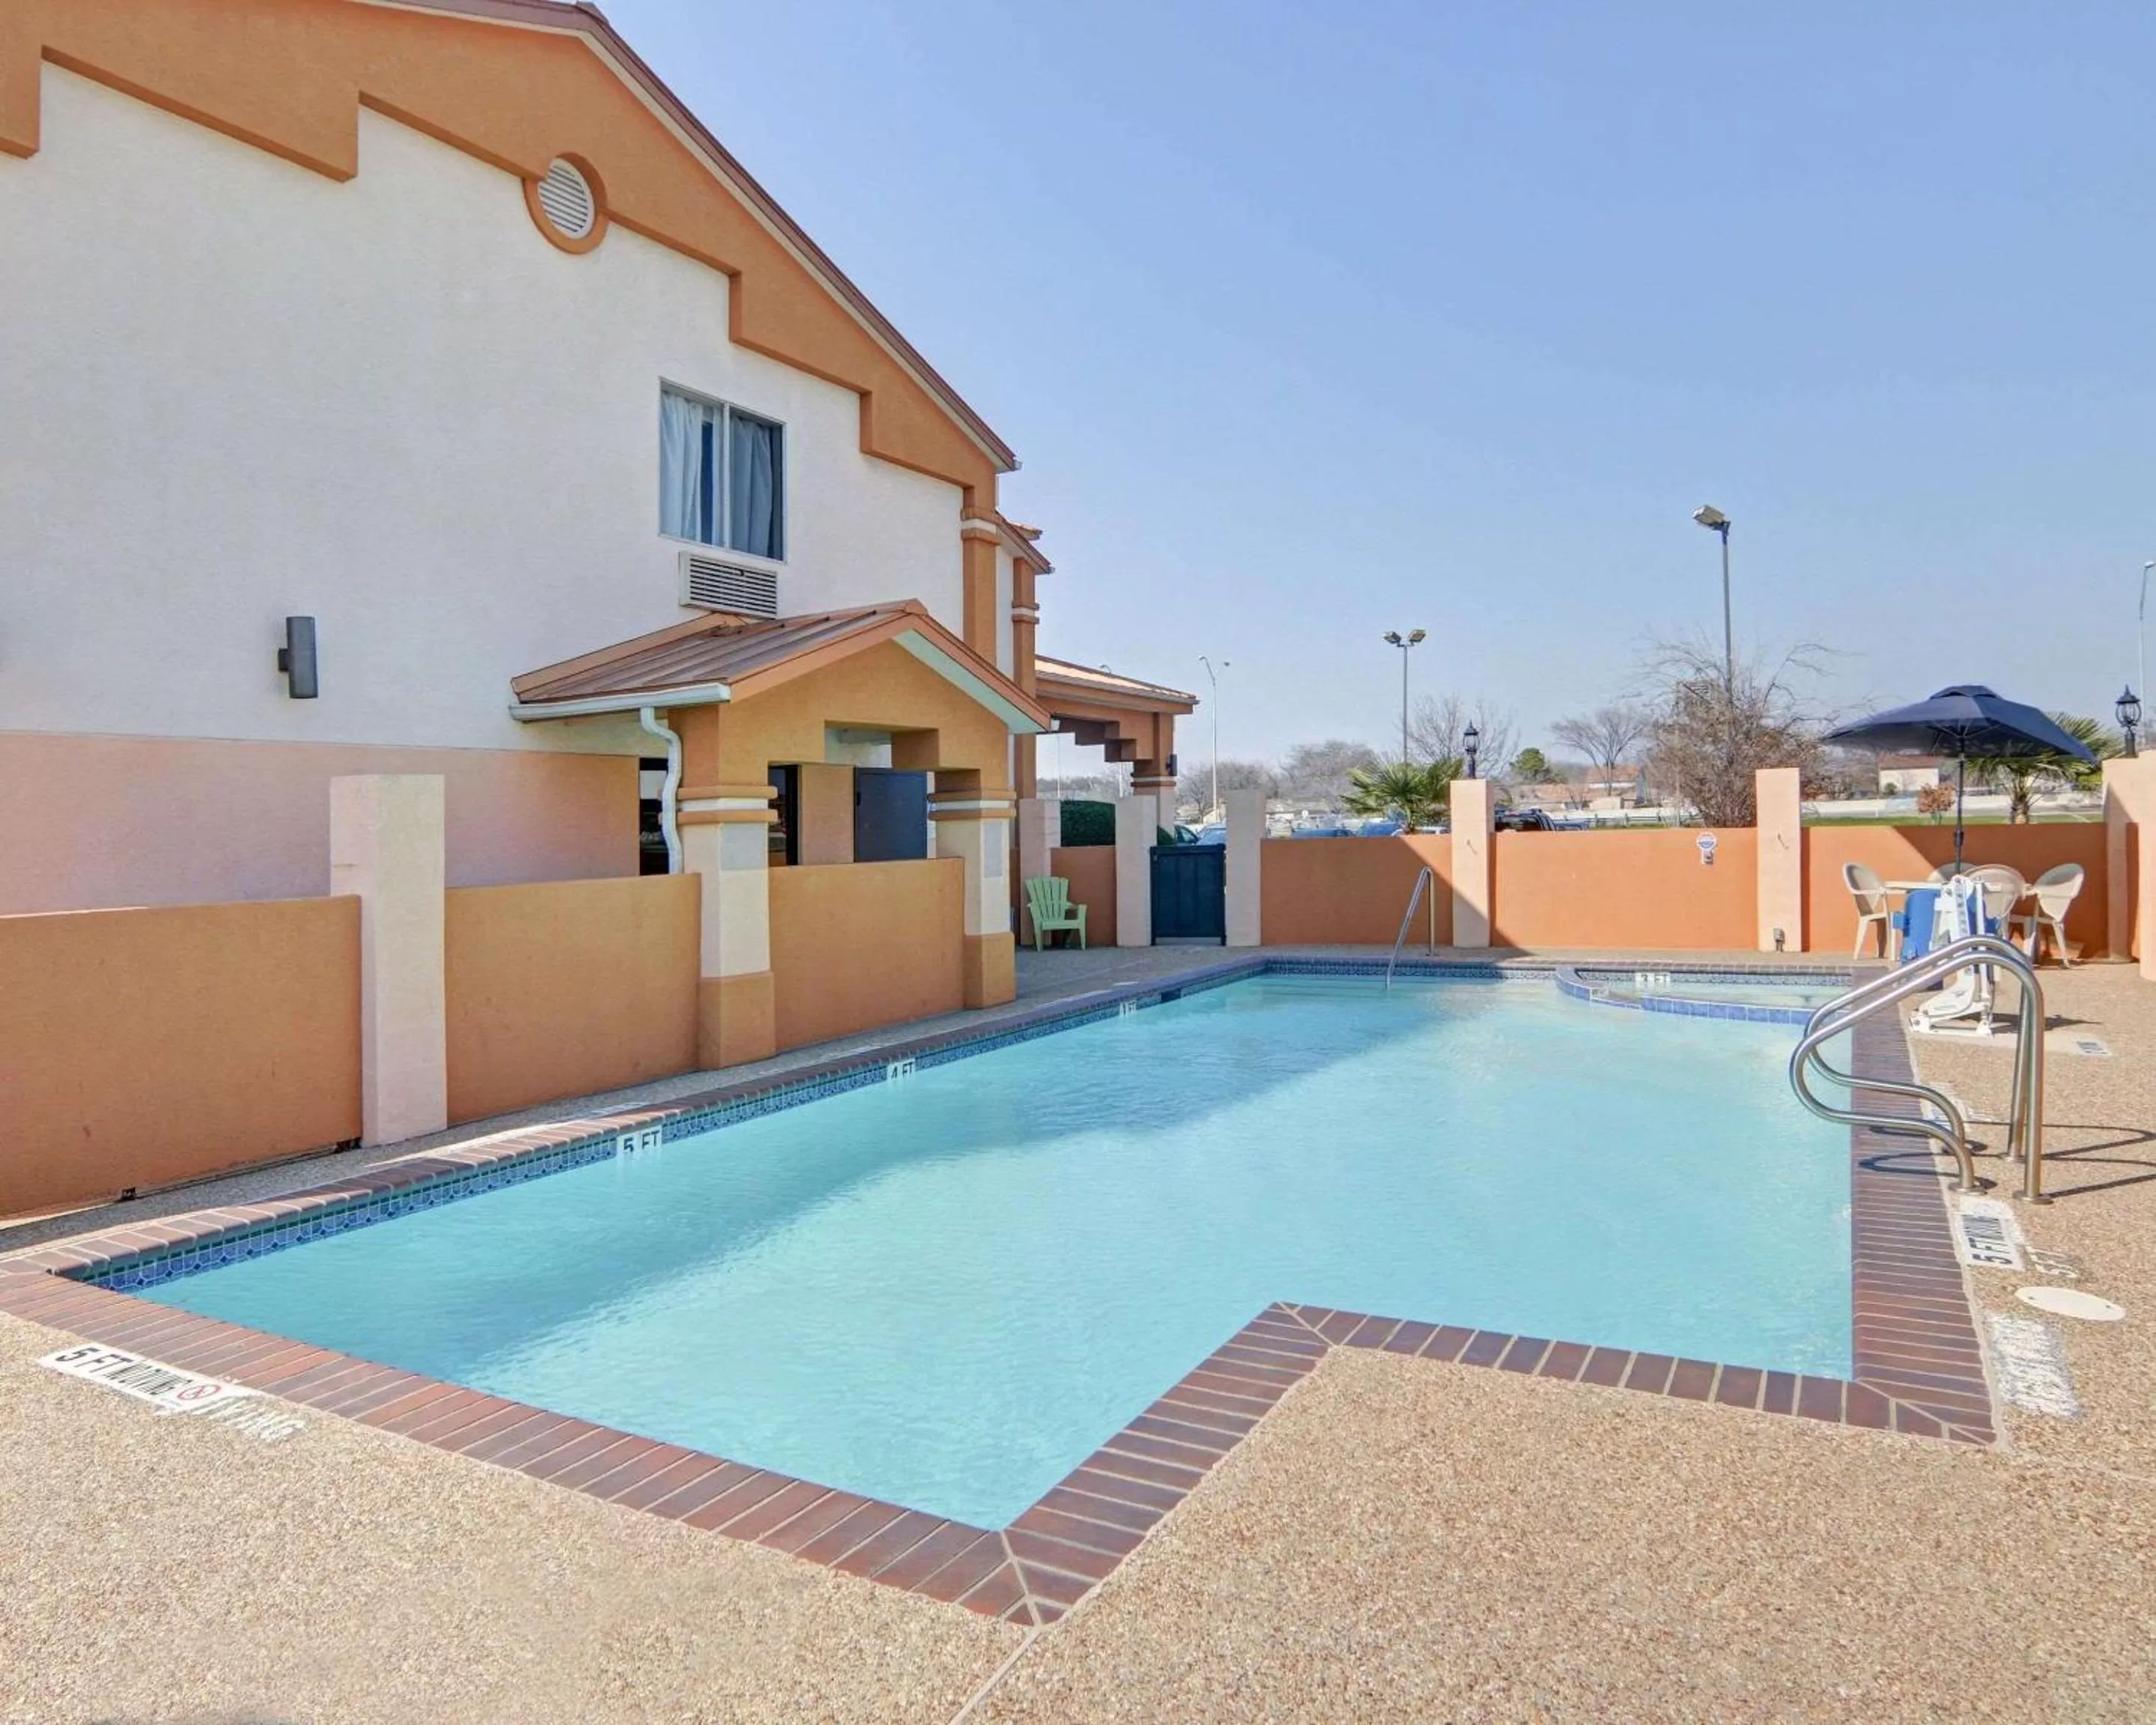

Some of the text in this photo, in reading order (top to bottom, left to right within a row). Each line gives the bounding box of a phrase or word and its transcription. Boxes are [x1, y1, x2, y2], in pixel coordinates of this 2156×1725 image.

[902, 1062, 913, 1078] FT
[623, 1129, 660, 1153] 5 FT
[1968, 1237, 2011, 1253] FT
[1972, 1253, 2012, 1264] 5
[55, 1346, 134, 1373] 5 FT
